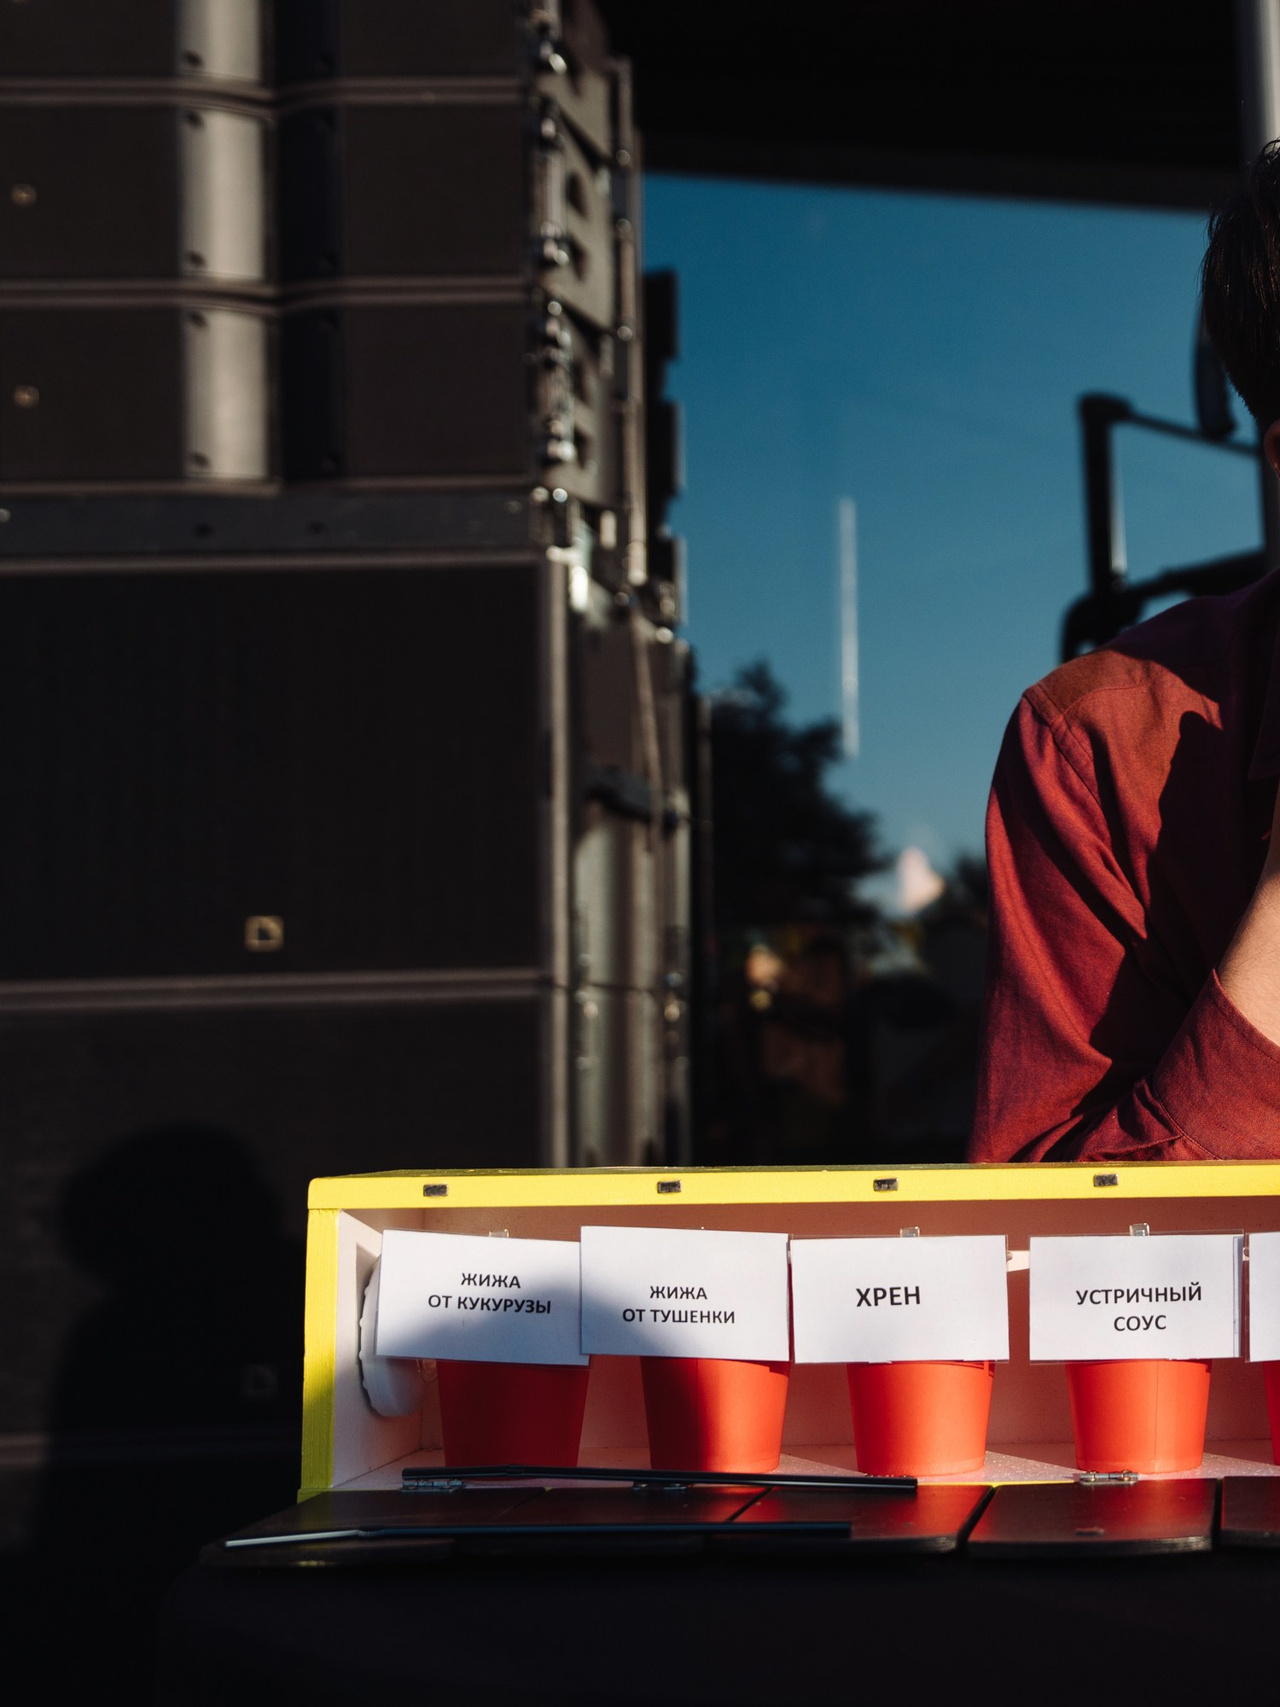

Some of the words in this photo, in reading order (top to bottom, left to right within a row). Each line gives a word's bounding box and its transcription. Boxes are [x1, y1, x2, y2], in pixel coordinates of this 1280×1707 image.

[460, 1272, 522, 1289] ЖИЖА
[649, 1285, 708, 1300] ЖИЖА
[855, 1285, 921, 1308] ХРЕН
[1075, 1281, 1202, 1306] УСТРИЧНЫЙ
[427, 1294, 453, 1309] ОТ
[457, 1296, 552, 1315] КУКУРУЗЫ
[622, 1308, 647, 1323] ОТ
[649, 1309, 735, 1324] ТУШЕНКИ
[1113, 1314, 1167, 1332] СОУС
